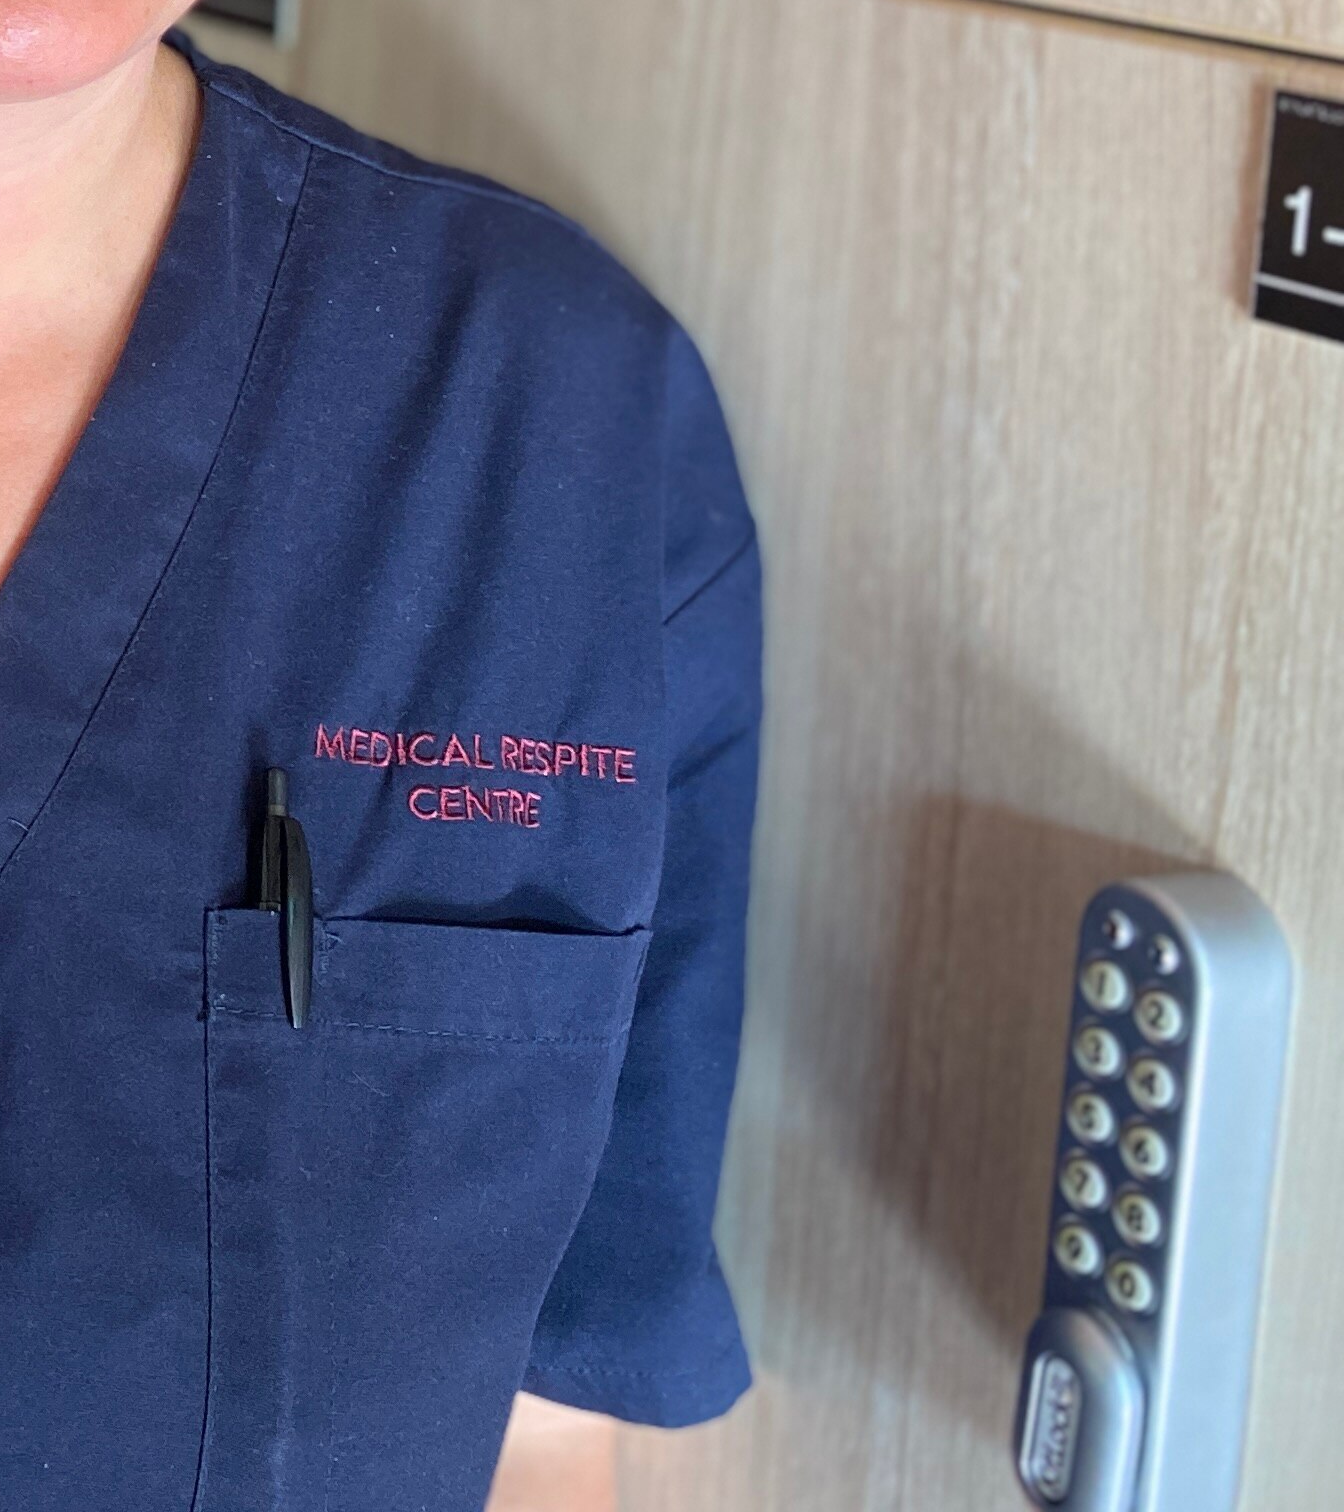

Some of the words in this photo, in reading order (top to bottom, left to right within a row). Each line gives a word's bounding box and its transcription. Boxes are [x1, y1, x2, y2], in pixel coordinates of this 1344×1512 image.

[314, 722, 495, 770] MEDICAL
[500, 734, 638, 784] RESPITE
[408, 786, 542, 829] CENTRE
[1095, 970, 1108, 998] 1
[1148, 999, 1166, 1029] 2
[1138, 1069, 1157, 1097] 4
[1080, 1101, 1096, 1130] 5
[1133, 1138, 1151, 1165] 6
[1075, 1167, 1090, 1194] 7
[1127, 1203, 1144, 1233] 8
